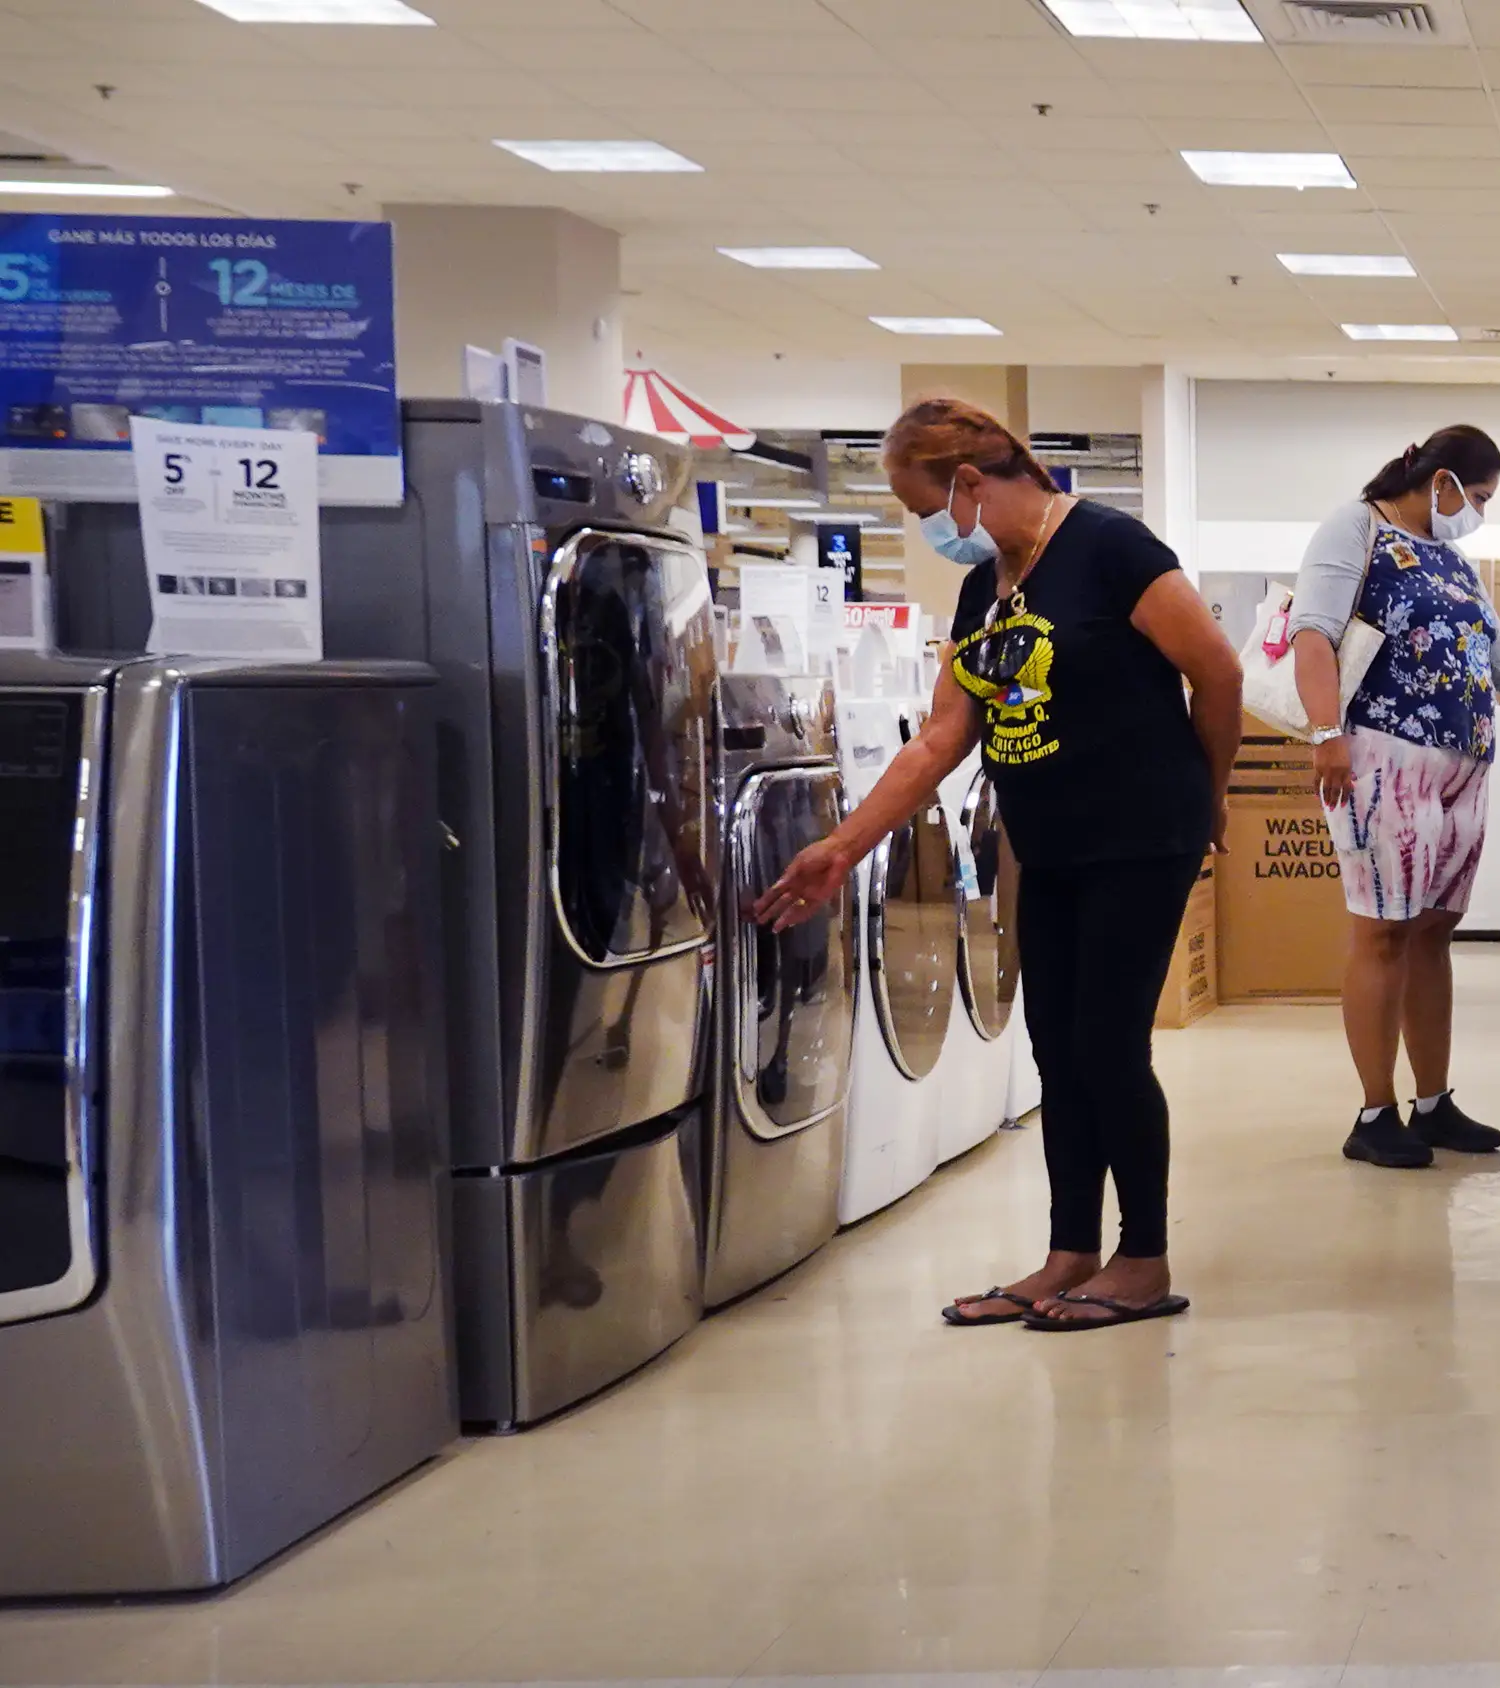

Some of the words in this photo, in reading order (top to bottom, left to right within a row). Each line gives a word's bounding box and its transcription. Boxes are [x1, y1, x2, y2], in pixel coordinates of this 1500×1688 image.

[48, 228, 97, 245] GANE
[101, 227, 135, 245] MÁS
[139, 230, 198, 247] TODOS
[200, 232, 234, 247] LOS
[208, 258, 268, 306] 12
[238, 458, 280, 489] 12
[817, 585, 829, 602] 12
[992, 734, 1041, 752] CHICAGO
